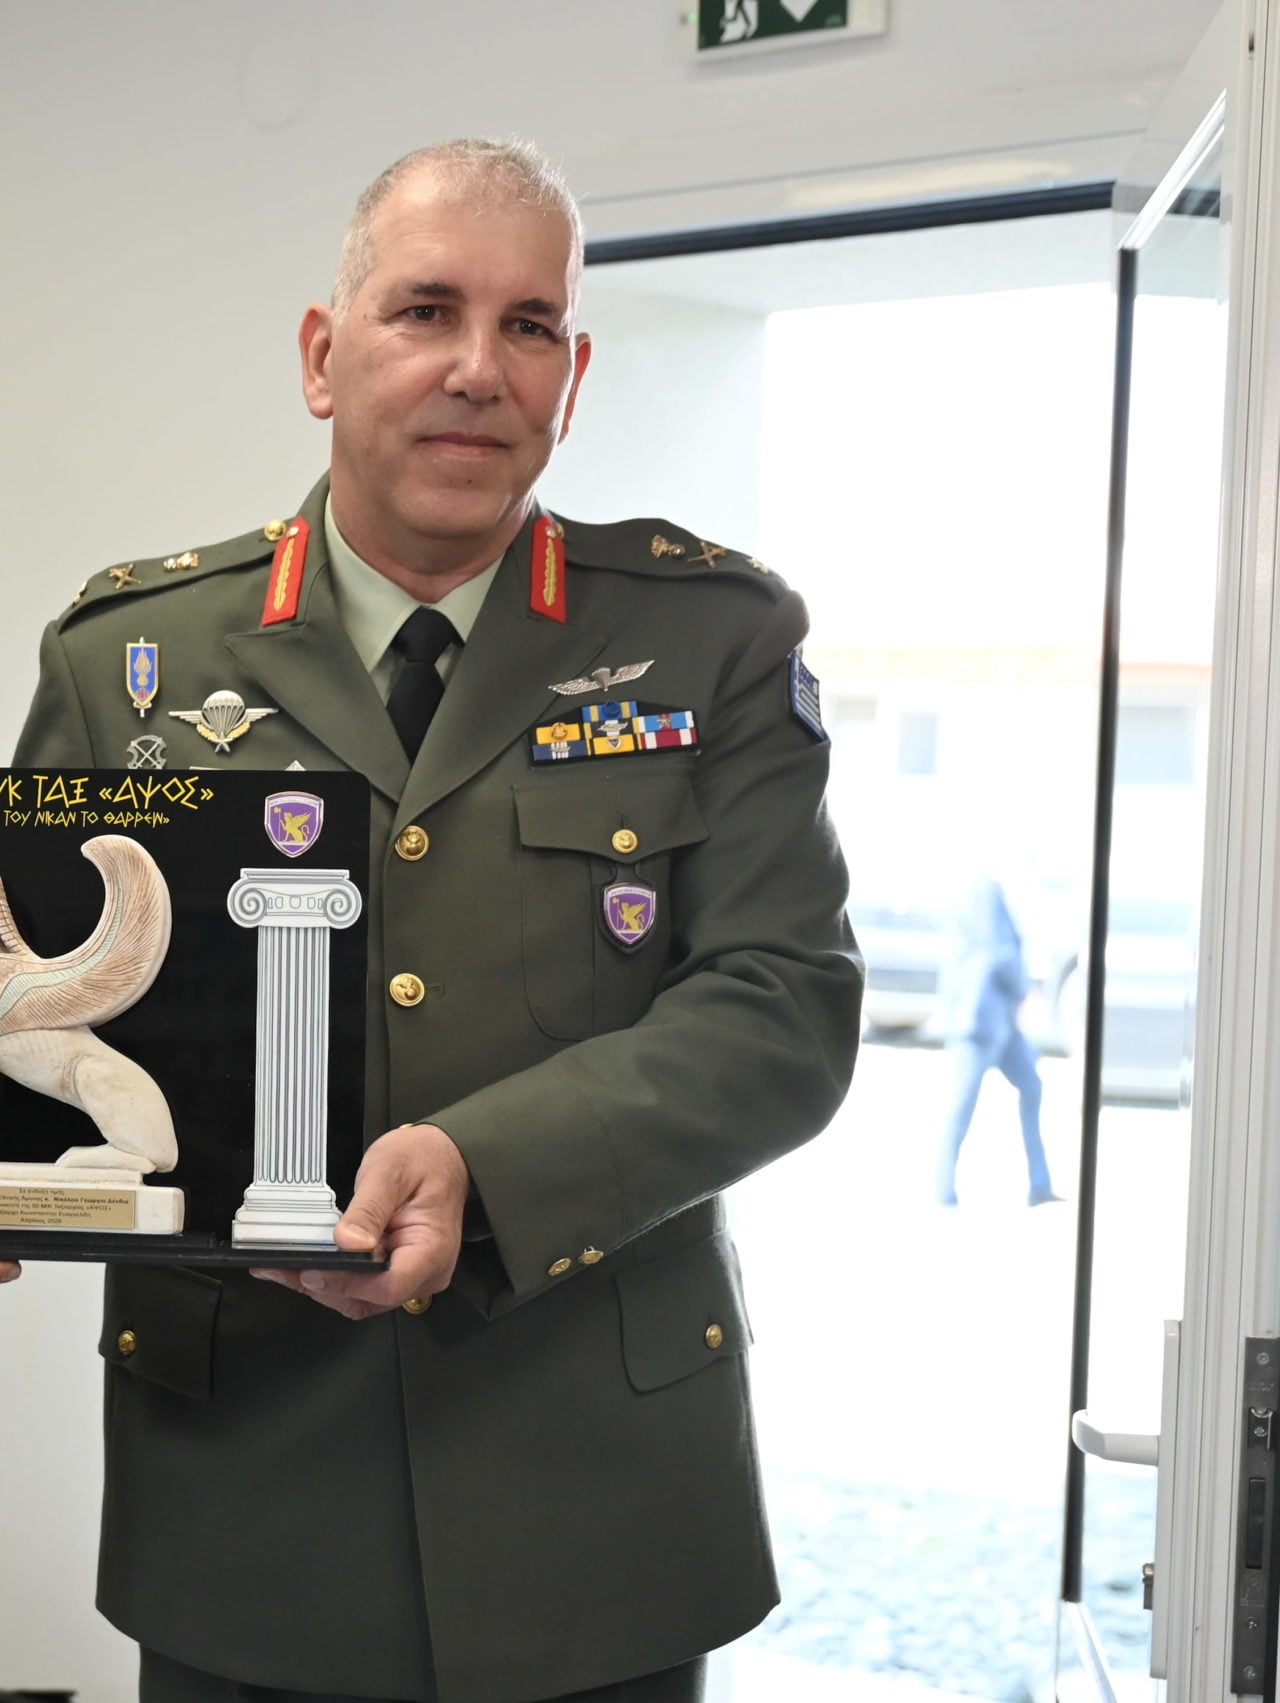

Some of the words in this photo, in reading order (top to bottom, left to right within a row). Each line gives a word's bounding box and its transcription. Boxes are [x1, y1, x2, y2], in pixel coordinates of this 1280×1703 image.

[32, 775, 90, 809] ΤΑΞ
[98, 775, 215, 810] «ΑΨΟΣ»
[3, 810, 31, 827] ΤΟΥ
[34, 810, 77, 827] ΝΙΚΑΝ
[81, 811, 99, 827] ΤΟ
